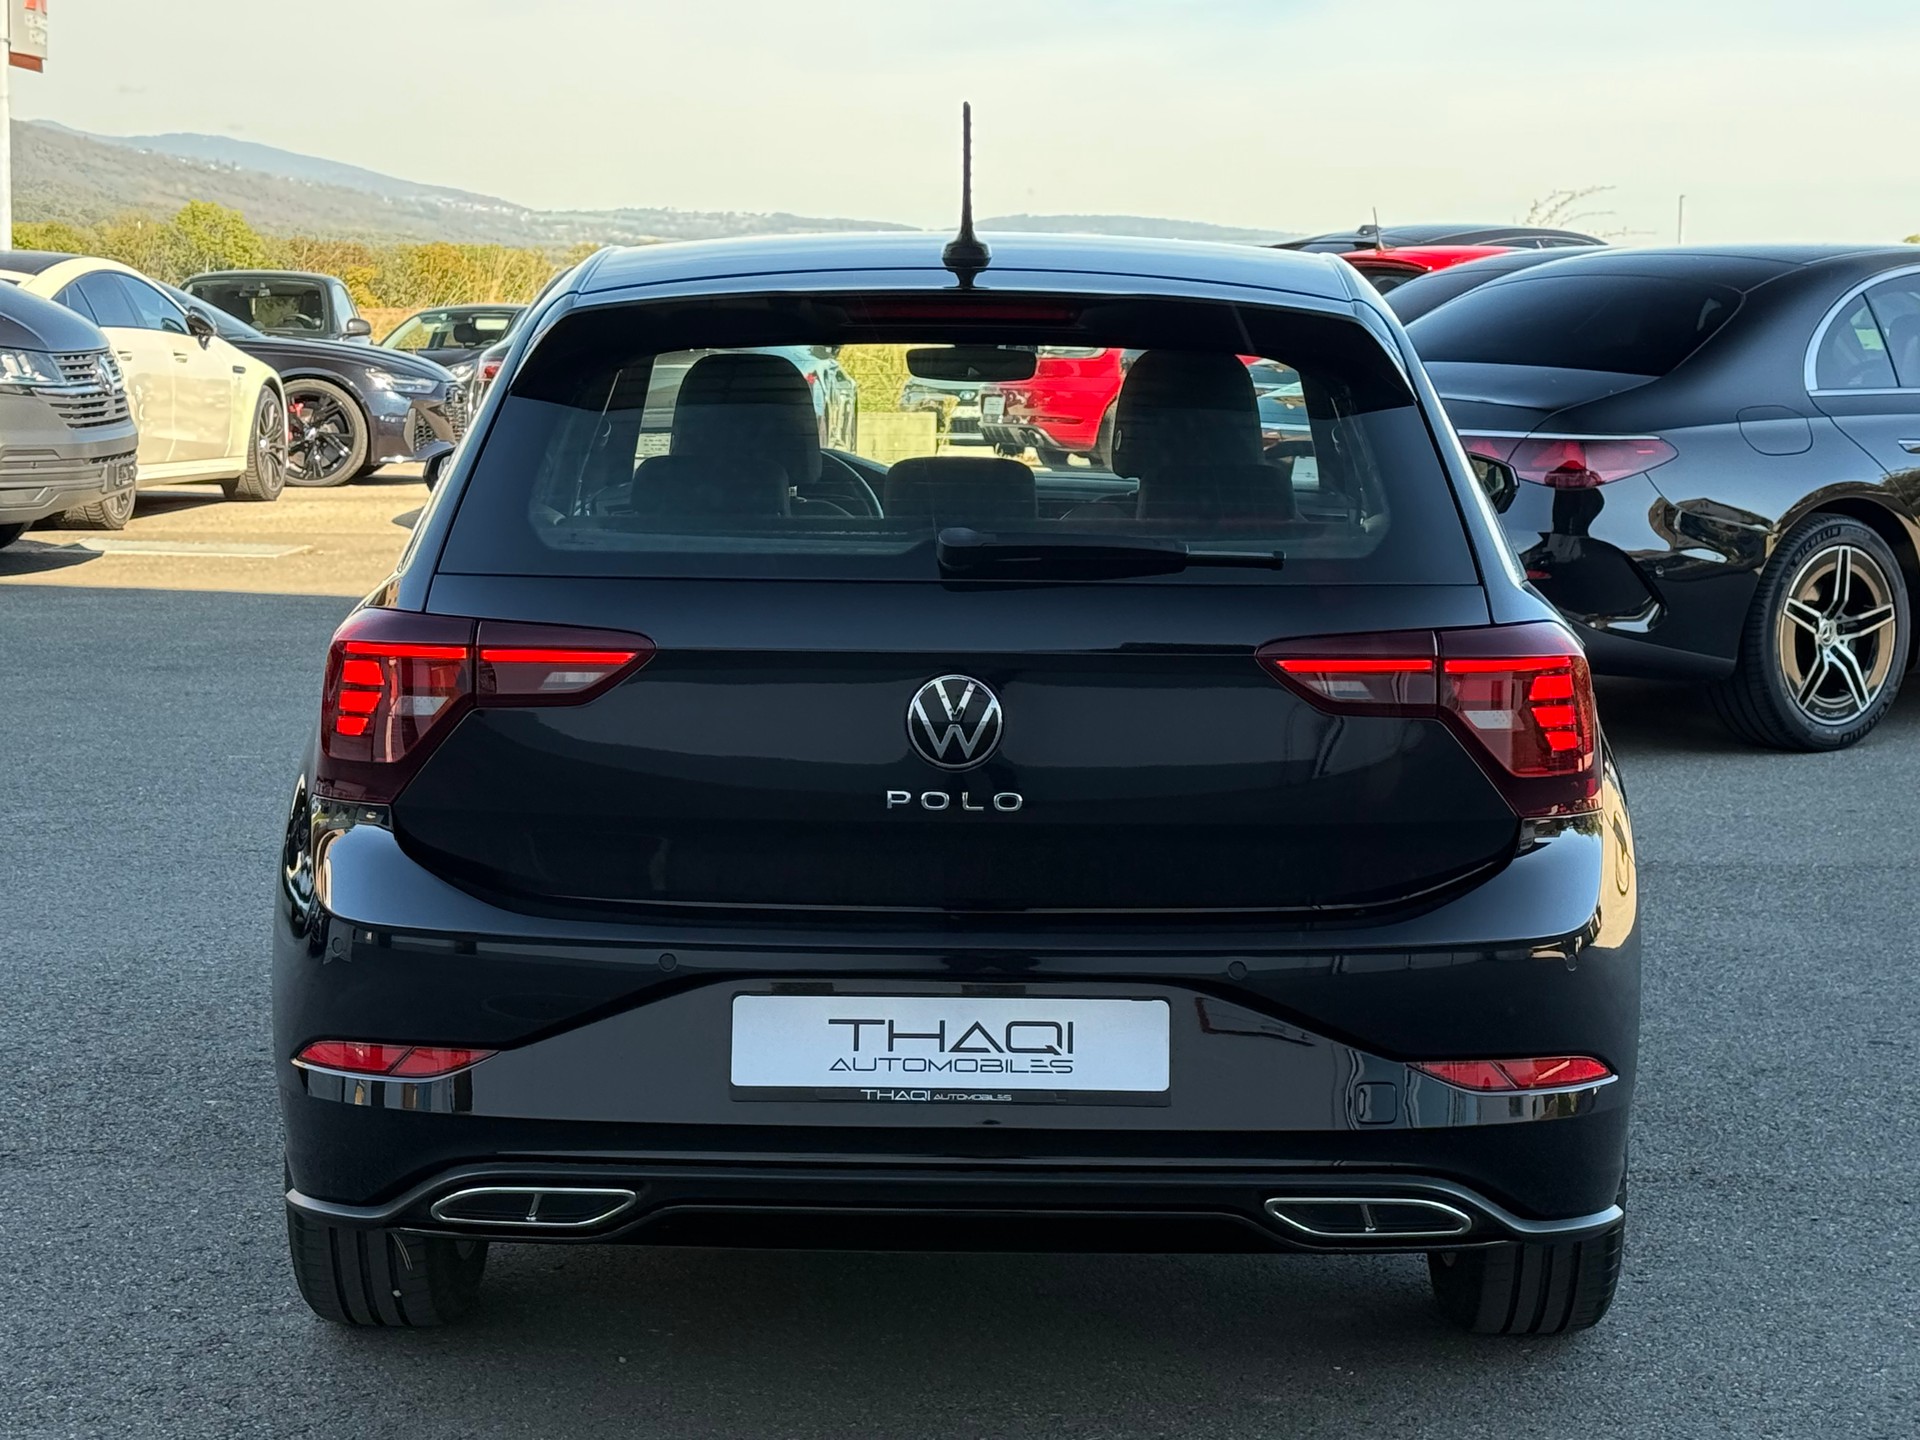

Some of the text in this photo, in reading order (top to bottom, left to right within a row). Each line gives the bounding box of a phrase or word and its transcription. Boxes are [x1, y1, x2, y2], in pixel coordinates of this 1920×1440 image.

[886, 790, 1023, 812] POLO
[828, 1018, 1074, 1056] THAQI
[828, 1057, 1074, 1075] AUTOMOBILES
[860, 1089, 1012, 1102] THAQI AUTOMOBILES
